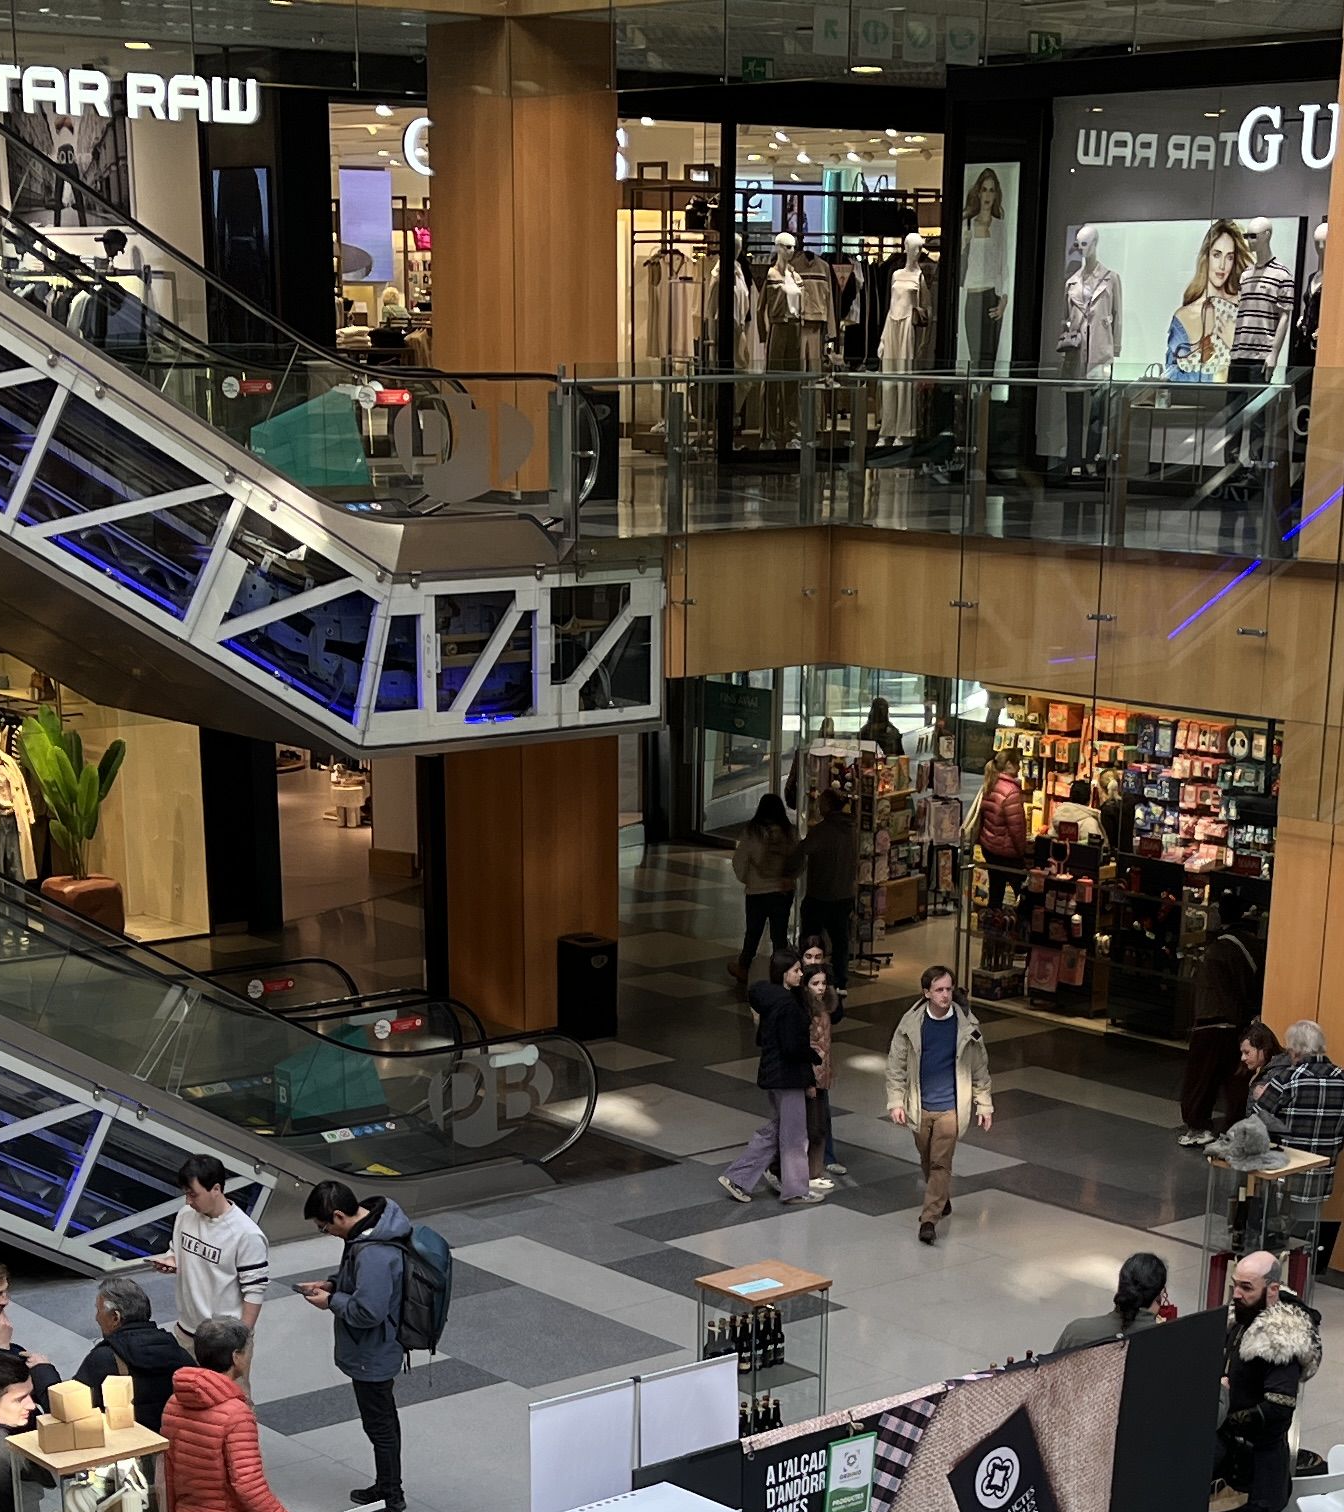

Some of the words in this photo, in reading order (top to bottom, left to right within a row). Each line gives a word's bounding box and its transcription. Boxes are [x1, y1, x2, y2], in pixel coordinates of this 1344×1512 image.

[126, 71, 262, 125] RAW
[1237, 102, 1341, 172] GU
[202, 1247, 219, 1263] AIR
[766, 1465, 776, 1487] A
[778, 1449, 827, 1483] L'ALÇAD
